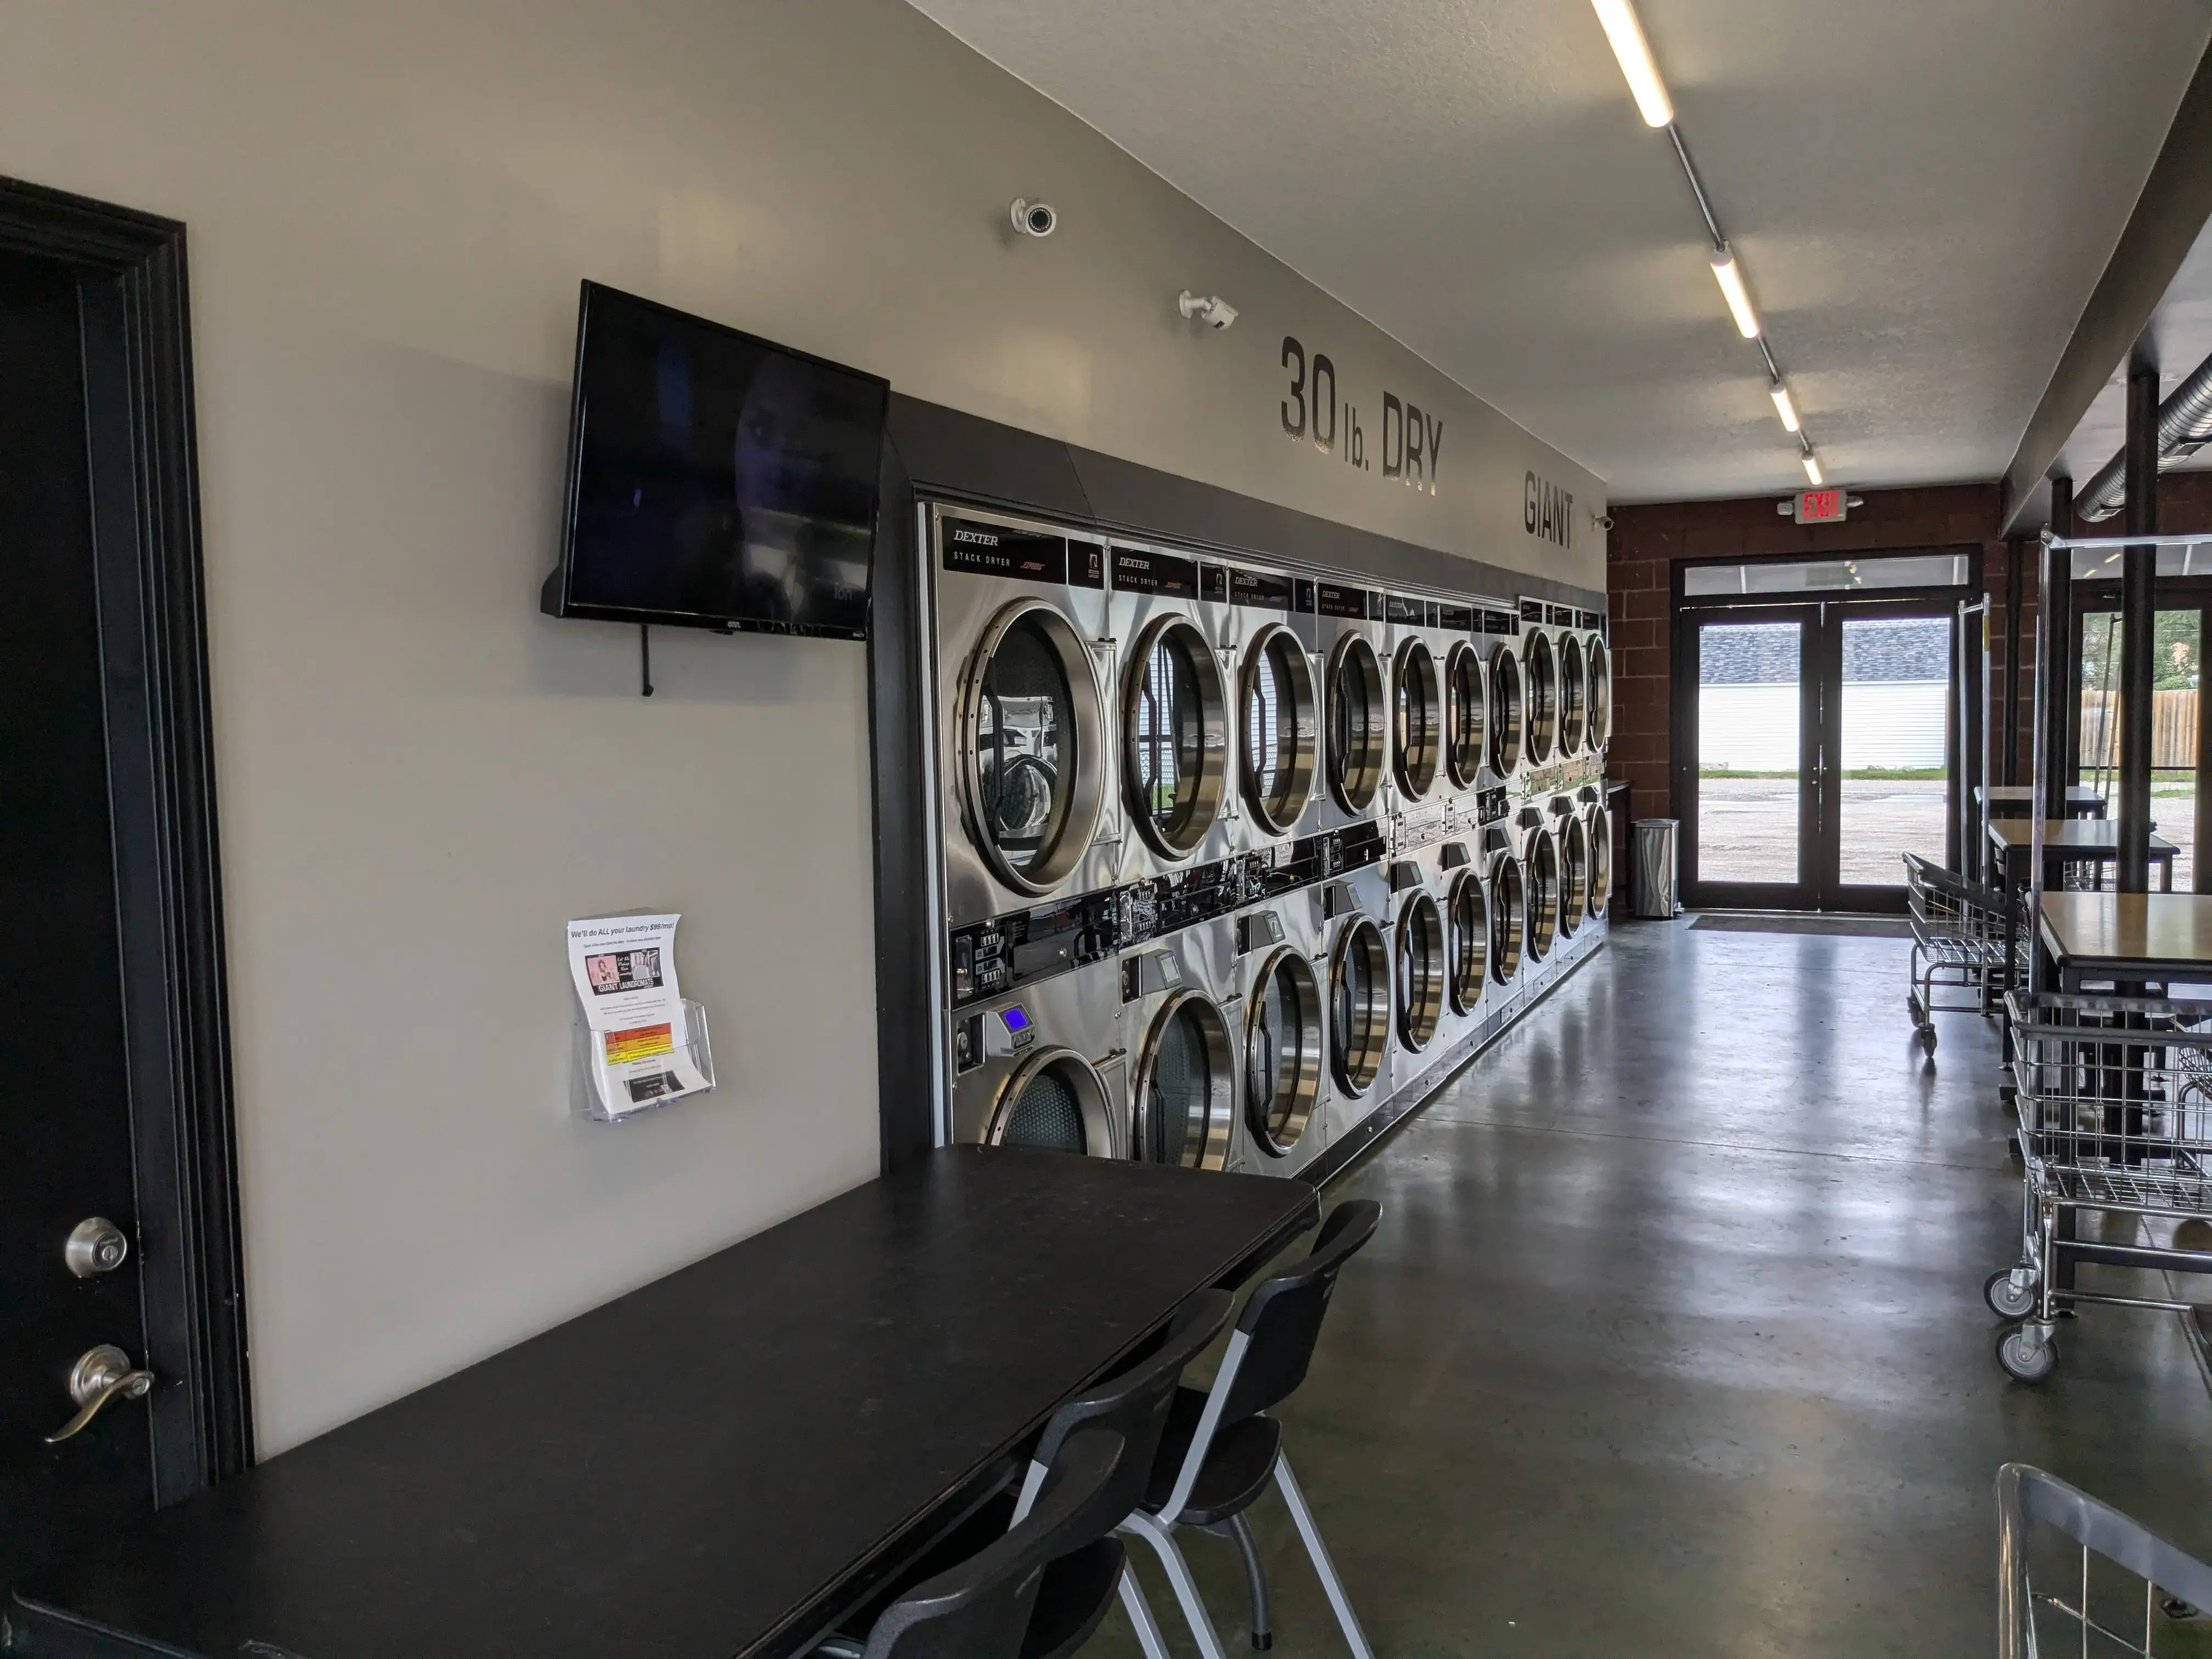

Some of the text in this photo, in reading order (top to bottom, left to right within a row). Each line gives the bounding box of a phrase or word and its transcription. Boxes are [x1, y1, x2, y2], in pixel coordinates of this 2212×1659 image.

[1281, 336, 1443, 496] 30 lb. DRY
[1524, 470, 1573, 549] GIANT
[1803, 490, 1840, 518] EXIT
[953, 529, 998, 546] DEXTER
[954, 551, 981, 563] STACK
[985, 556, 1011, 567] DRYER
[1119, 557, 1150, 570] DEXTER
[1119, 574, 1138, 584] STACK
[1141, 578, 1158, 586] DRYER
[1234, 577, 1258, 587] DEXTER
[1322, 590, 1340, 599] DEXTER
[571, 929, 588, 938] We'll
[598, 927, 610, 935] ALL
[611, 928, 624, 936] your
[626, 924, 649, 933] laundry
[650, 922, 675, 930] $99/mo!
[599, 978, 654, 992] GIANT LAUNDROMATS
